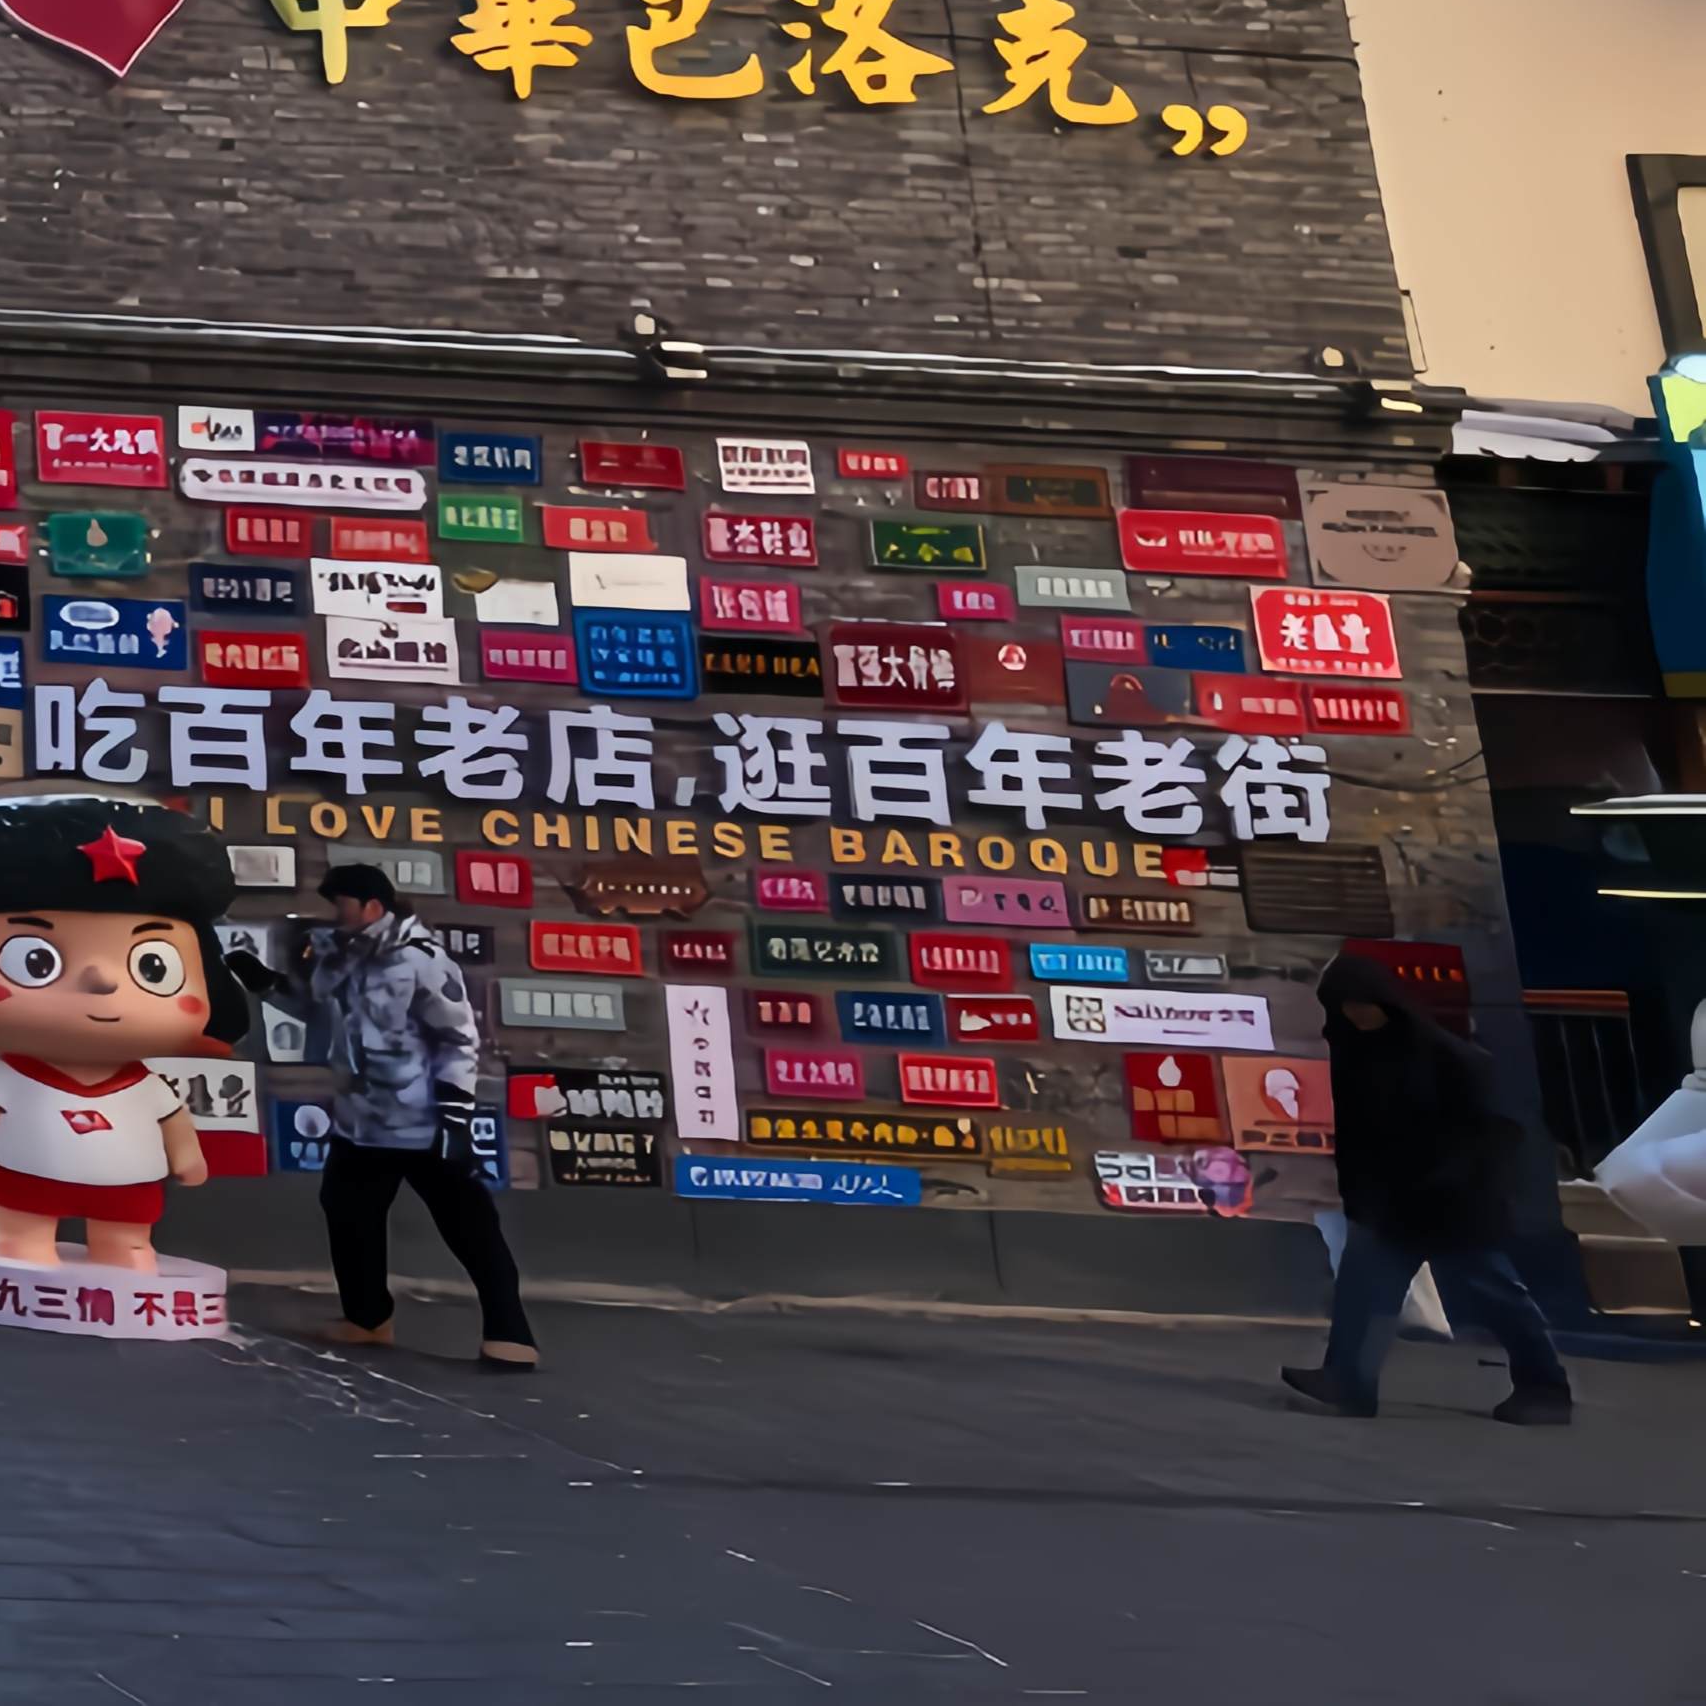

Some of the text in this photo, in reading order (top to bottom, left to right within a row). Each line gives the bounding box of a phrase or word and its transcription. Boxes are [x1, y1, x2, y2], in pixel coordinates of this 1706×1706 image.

[265, 796, 445, 843] LOVE
[482, 811, 794, 862] CHINESE
[828, 826, 1171, 879] BAROQUE
